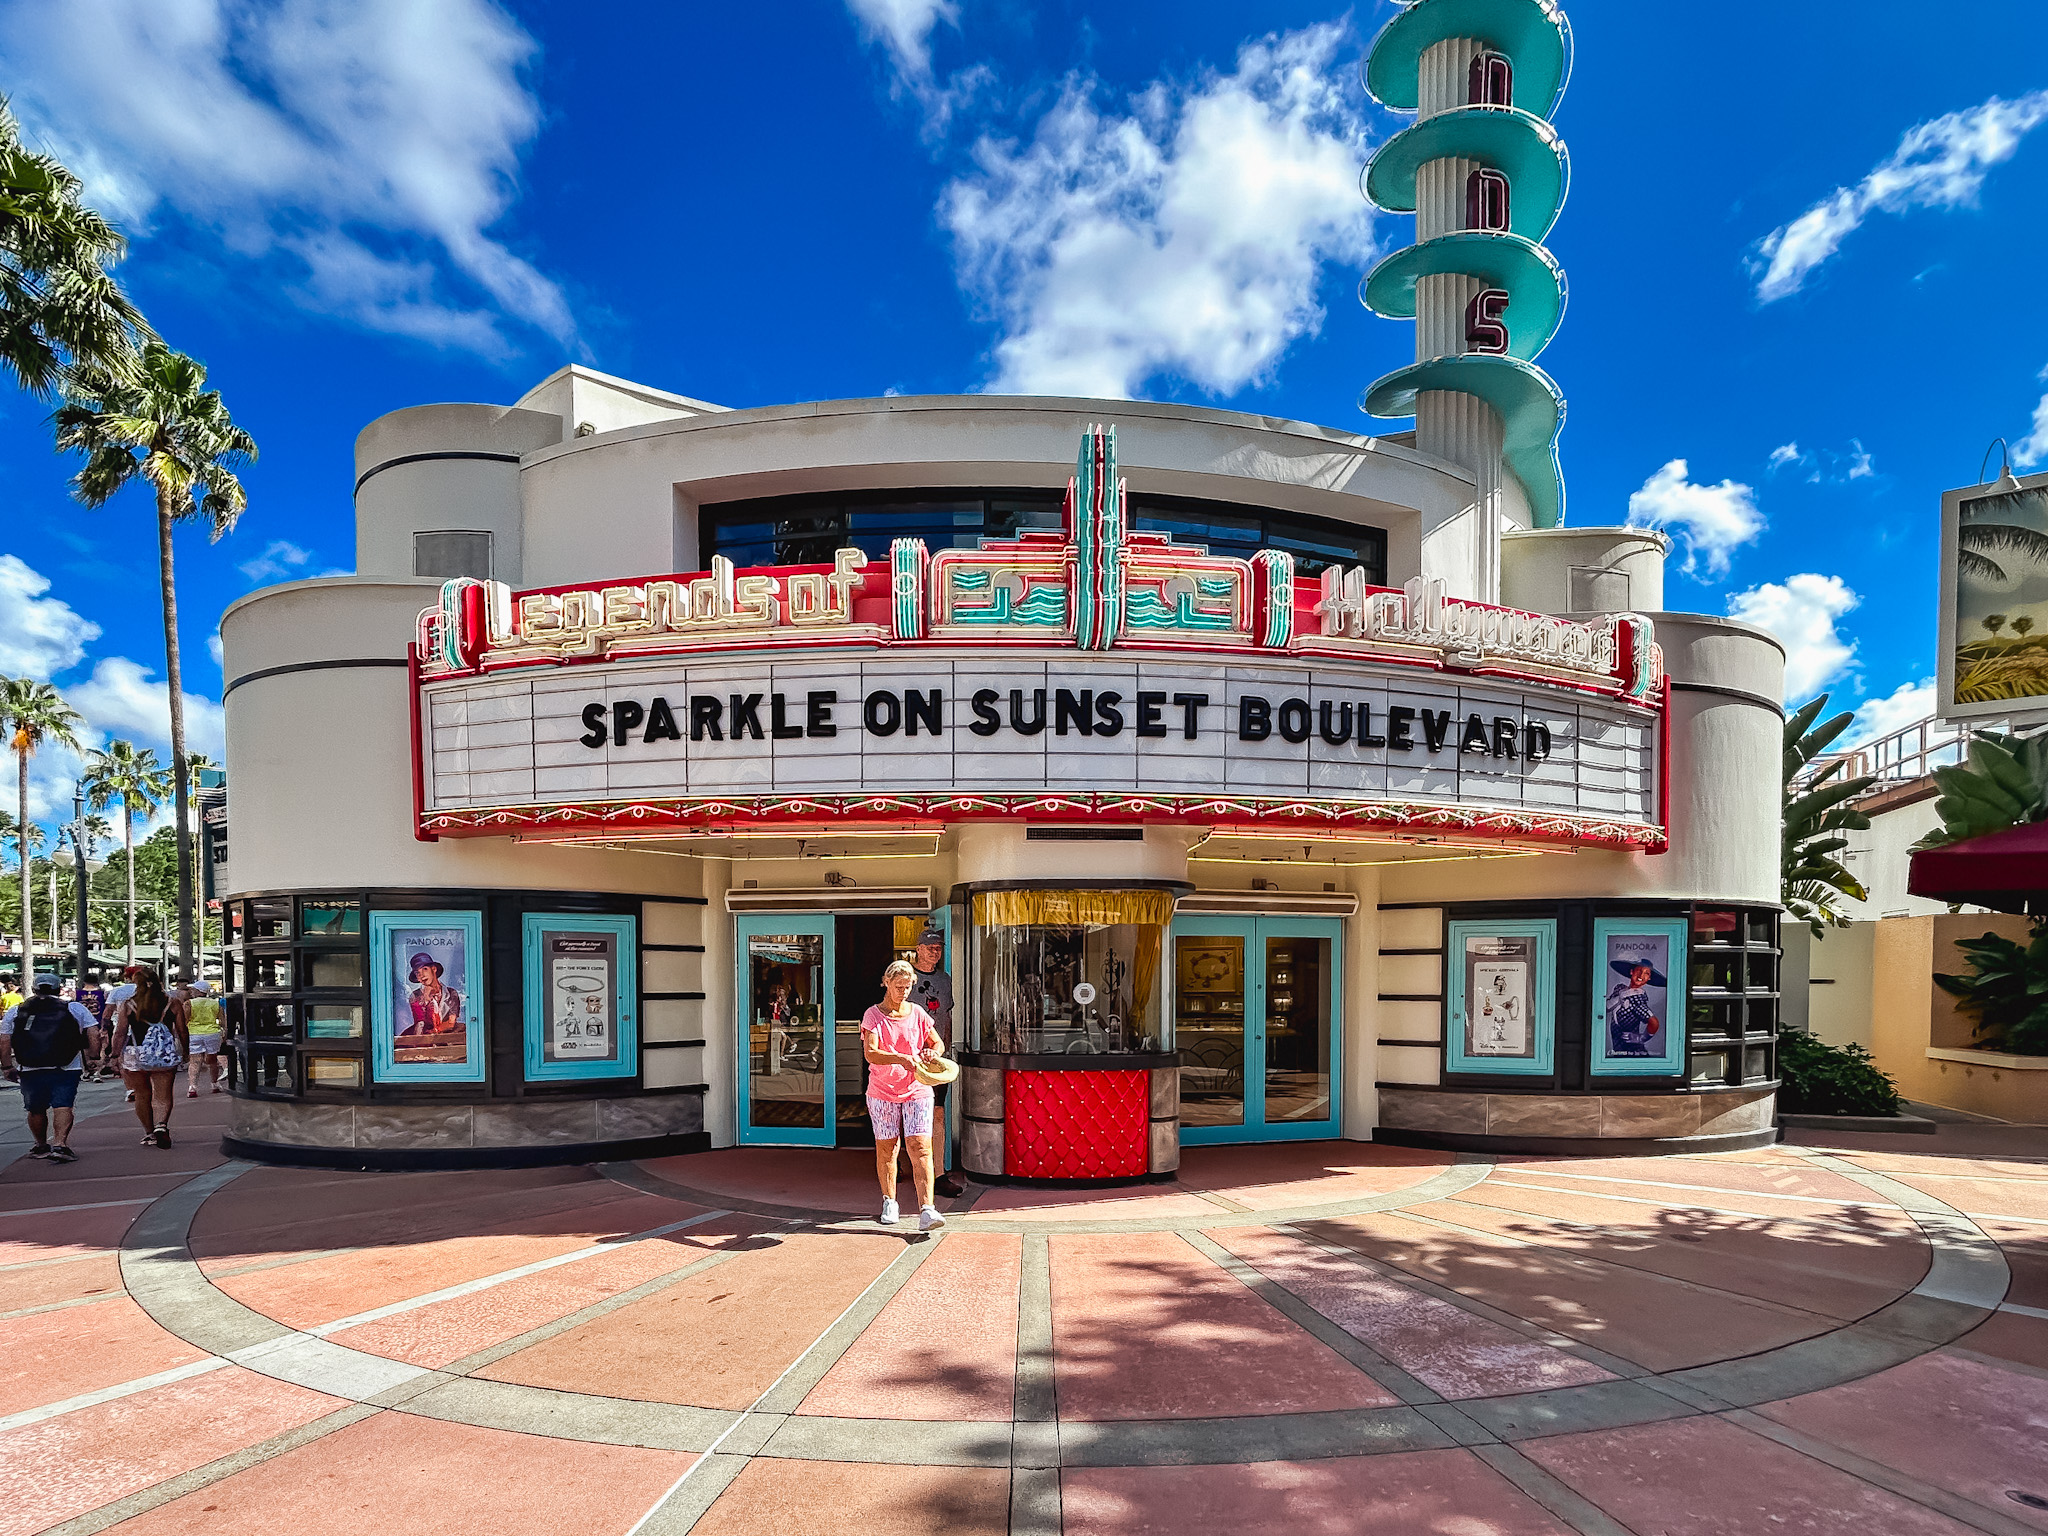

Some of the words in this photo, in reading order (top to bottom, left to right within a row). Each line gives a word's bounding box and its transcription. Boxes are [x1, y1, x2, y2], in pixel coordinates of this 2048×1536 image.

[788, 546, 868, 626] of
[580, 689, 838, 749] SPARKLE
[863, 688, 943, 737] ON
[968, 688, 1209, 739] SUNSET
[1239, 693, 1552, 763] BOULEVARD
[406, 935, 454, 946] PANDORA
[1615, 941, 1657, 951] PANDORA
